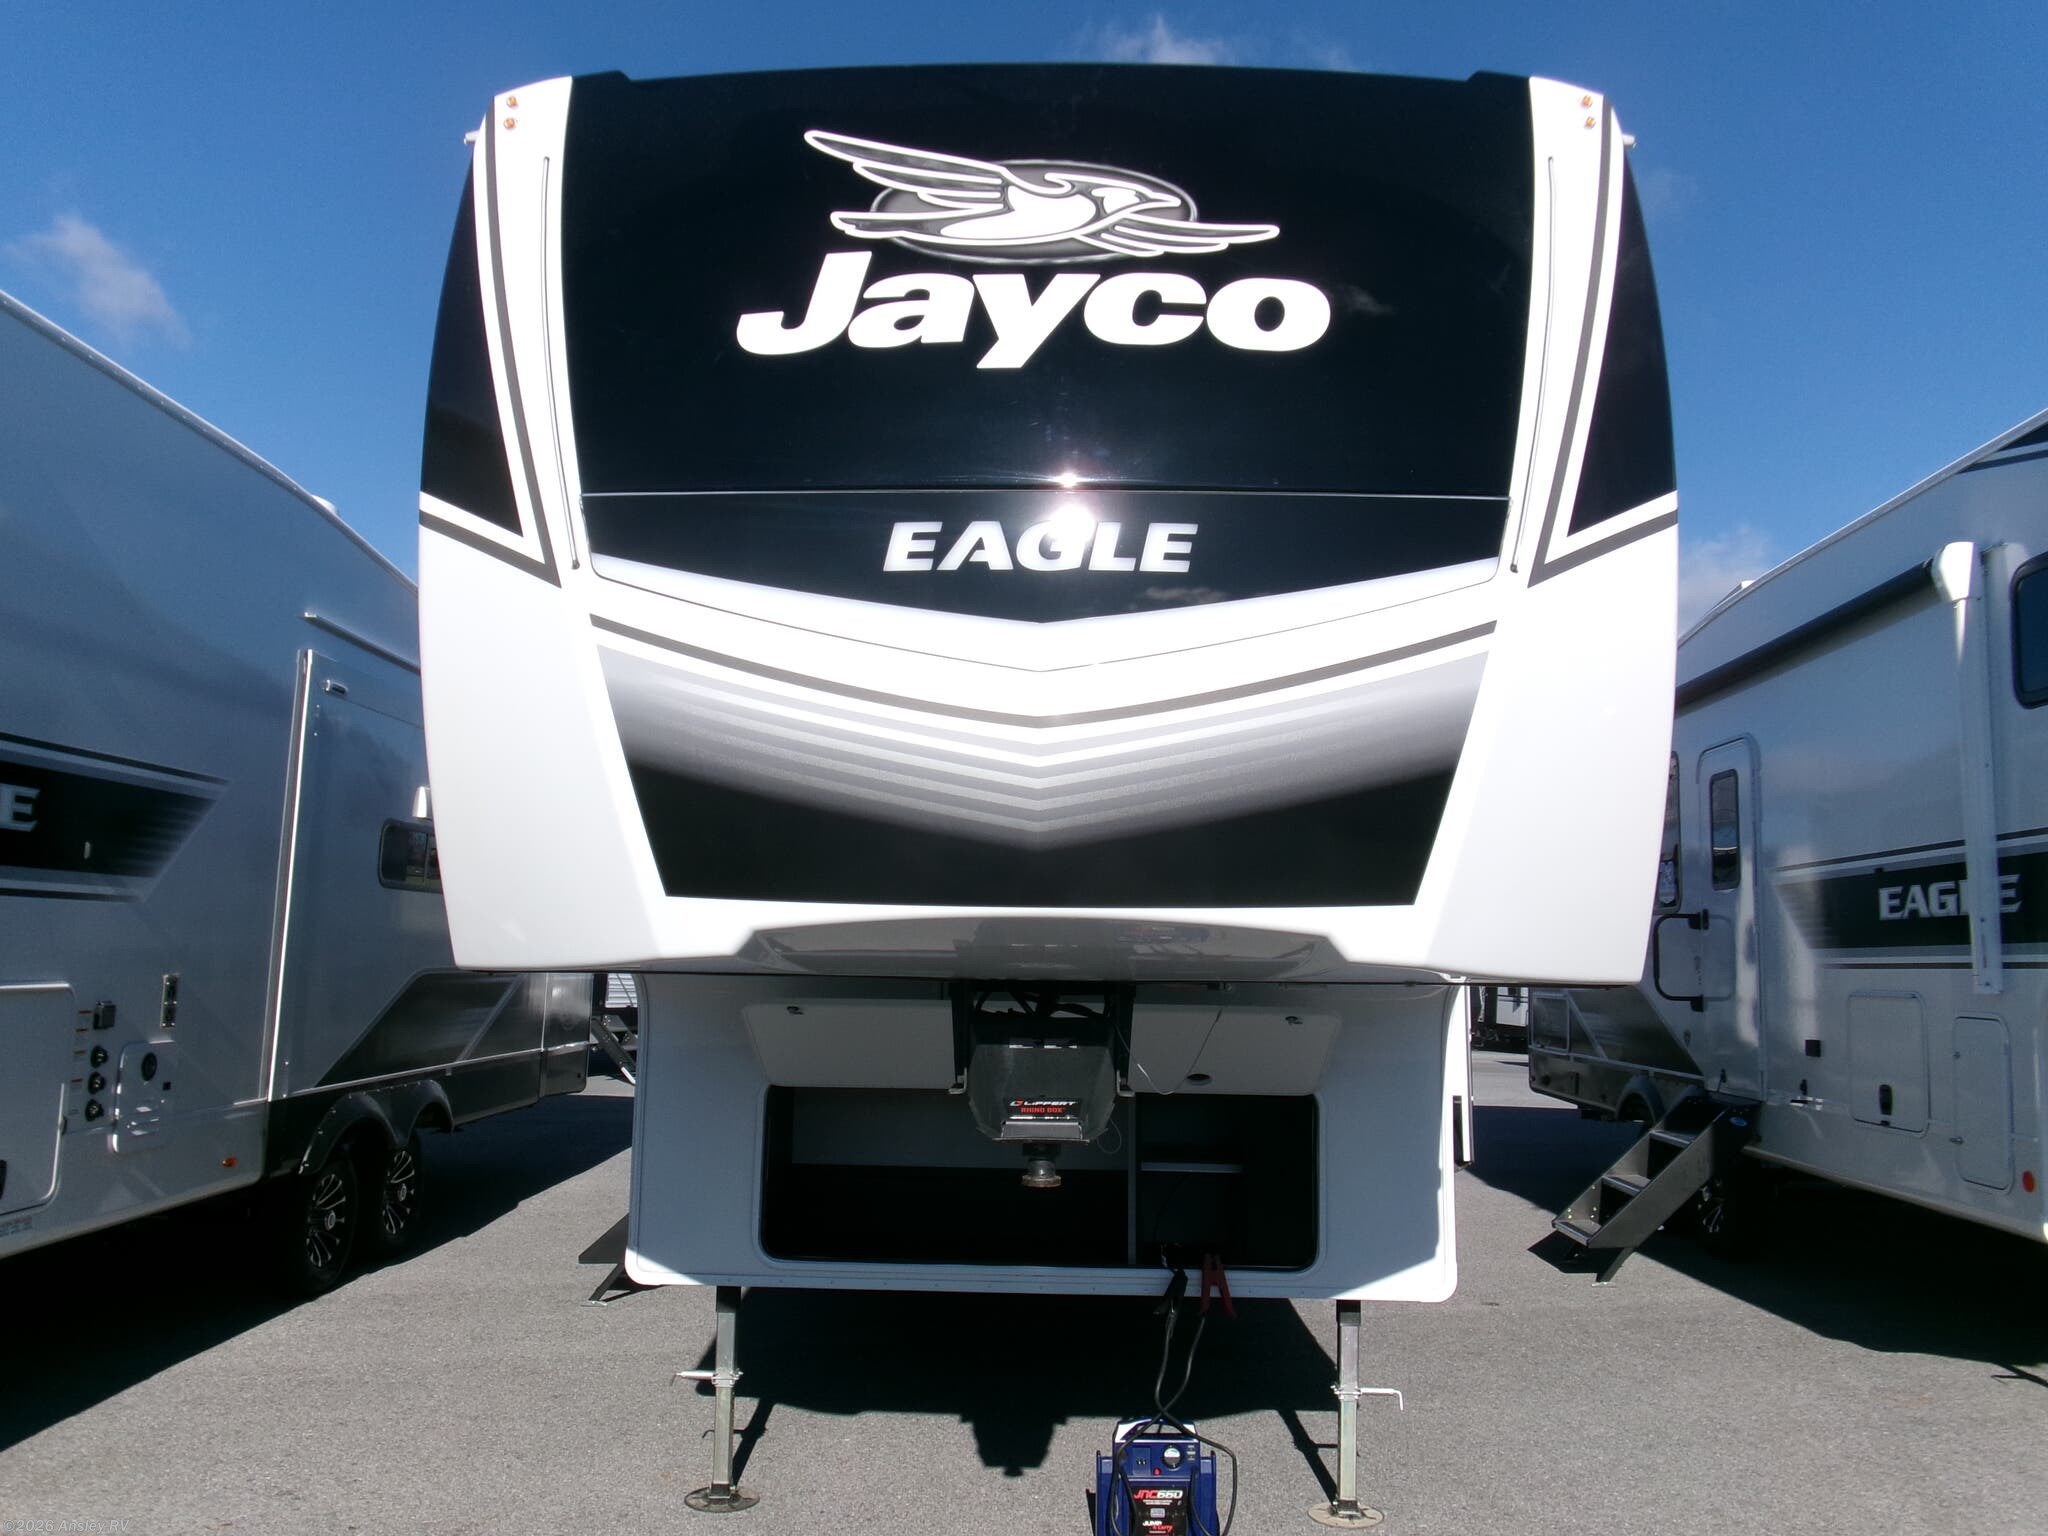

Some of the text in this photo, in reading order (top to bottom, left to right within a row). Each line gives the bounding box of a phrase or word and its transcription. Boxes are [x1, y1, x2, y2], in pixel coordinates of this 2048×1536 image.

[736, 251, 1332, 369] Jayco
[883, 521, 1199, 572] EAGLE
[1878, 874, 2023, 920] EAGE
